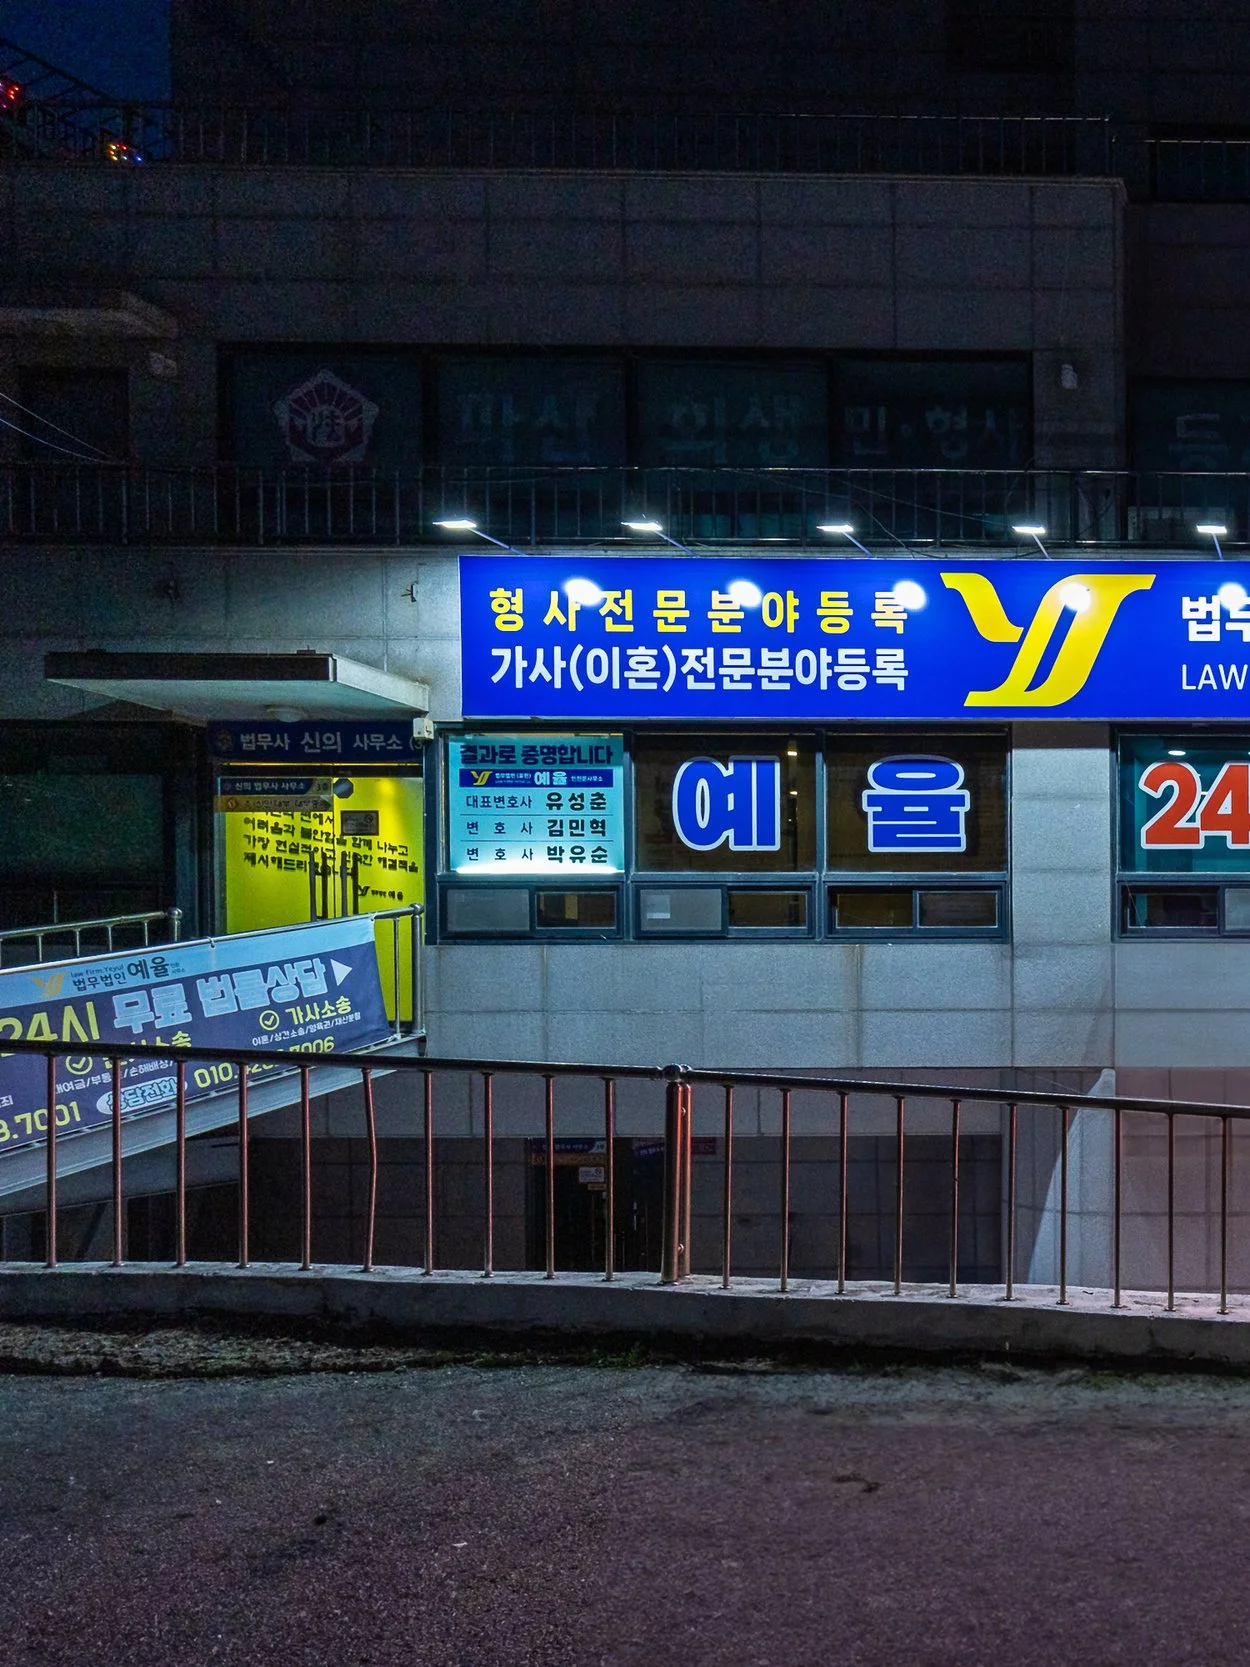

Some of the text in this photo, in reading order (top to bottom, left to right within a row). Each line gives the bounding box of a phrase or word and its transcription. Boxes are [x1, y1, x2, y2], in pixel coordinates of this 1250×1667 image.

[490, 644, 909, 693] 가사(이혼)전문분야등록
[1181, 664, 1249, 691] LAW
[240, 732, 290, 751] 법무사
[301, 731, 342, 753] 신의
[353, 733, 404, 751] 사무소
[460, 744, 613, 765] 결과로 증명합니다
[534, 771, 567, 786] 예율
[465, 791, 607, 811] 대표변호사 유성춘
[243, 817, 295, 837] 어려움과
[377, 840, 409, 856] 나누고
[466, 818, 606, 837] 변호사 김민혁
[243, 835, 269, 849] 가장
[466, 845, 608, 863] 변호사 박유순
[72, 956, 170, 992] 법무법인 예율
[112, 983, 193, 1034] 무료
[198, 958, 328, 1018] 법률상담
[285, 995, 352, 1025] 가사소송
